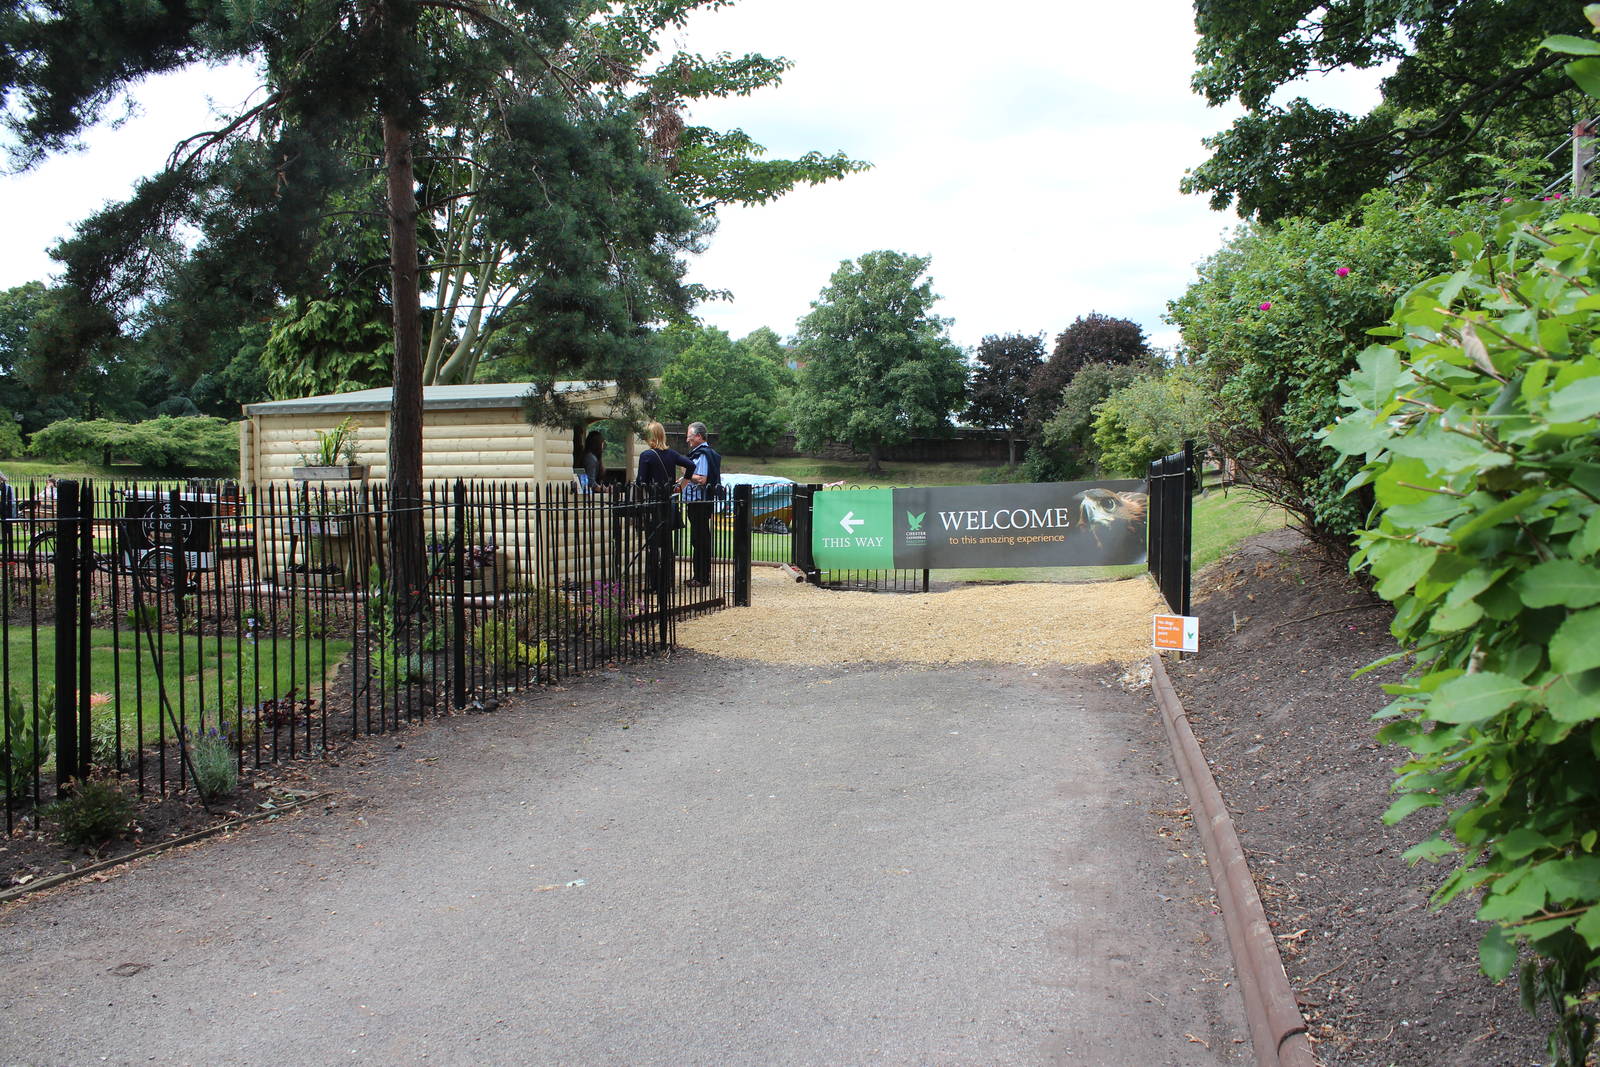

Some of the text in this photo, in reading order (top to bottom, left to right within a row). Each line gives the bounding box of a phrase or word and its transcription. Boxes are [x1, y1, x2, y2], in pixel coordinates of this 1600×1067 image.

[938, 507, 1070, 531] WELCOME
[822, 536, 884, 548] THIS WAY
[949, 534, 1065, 546] to this amazing experience
